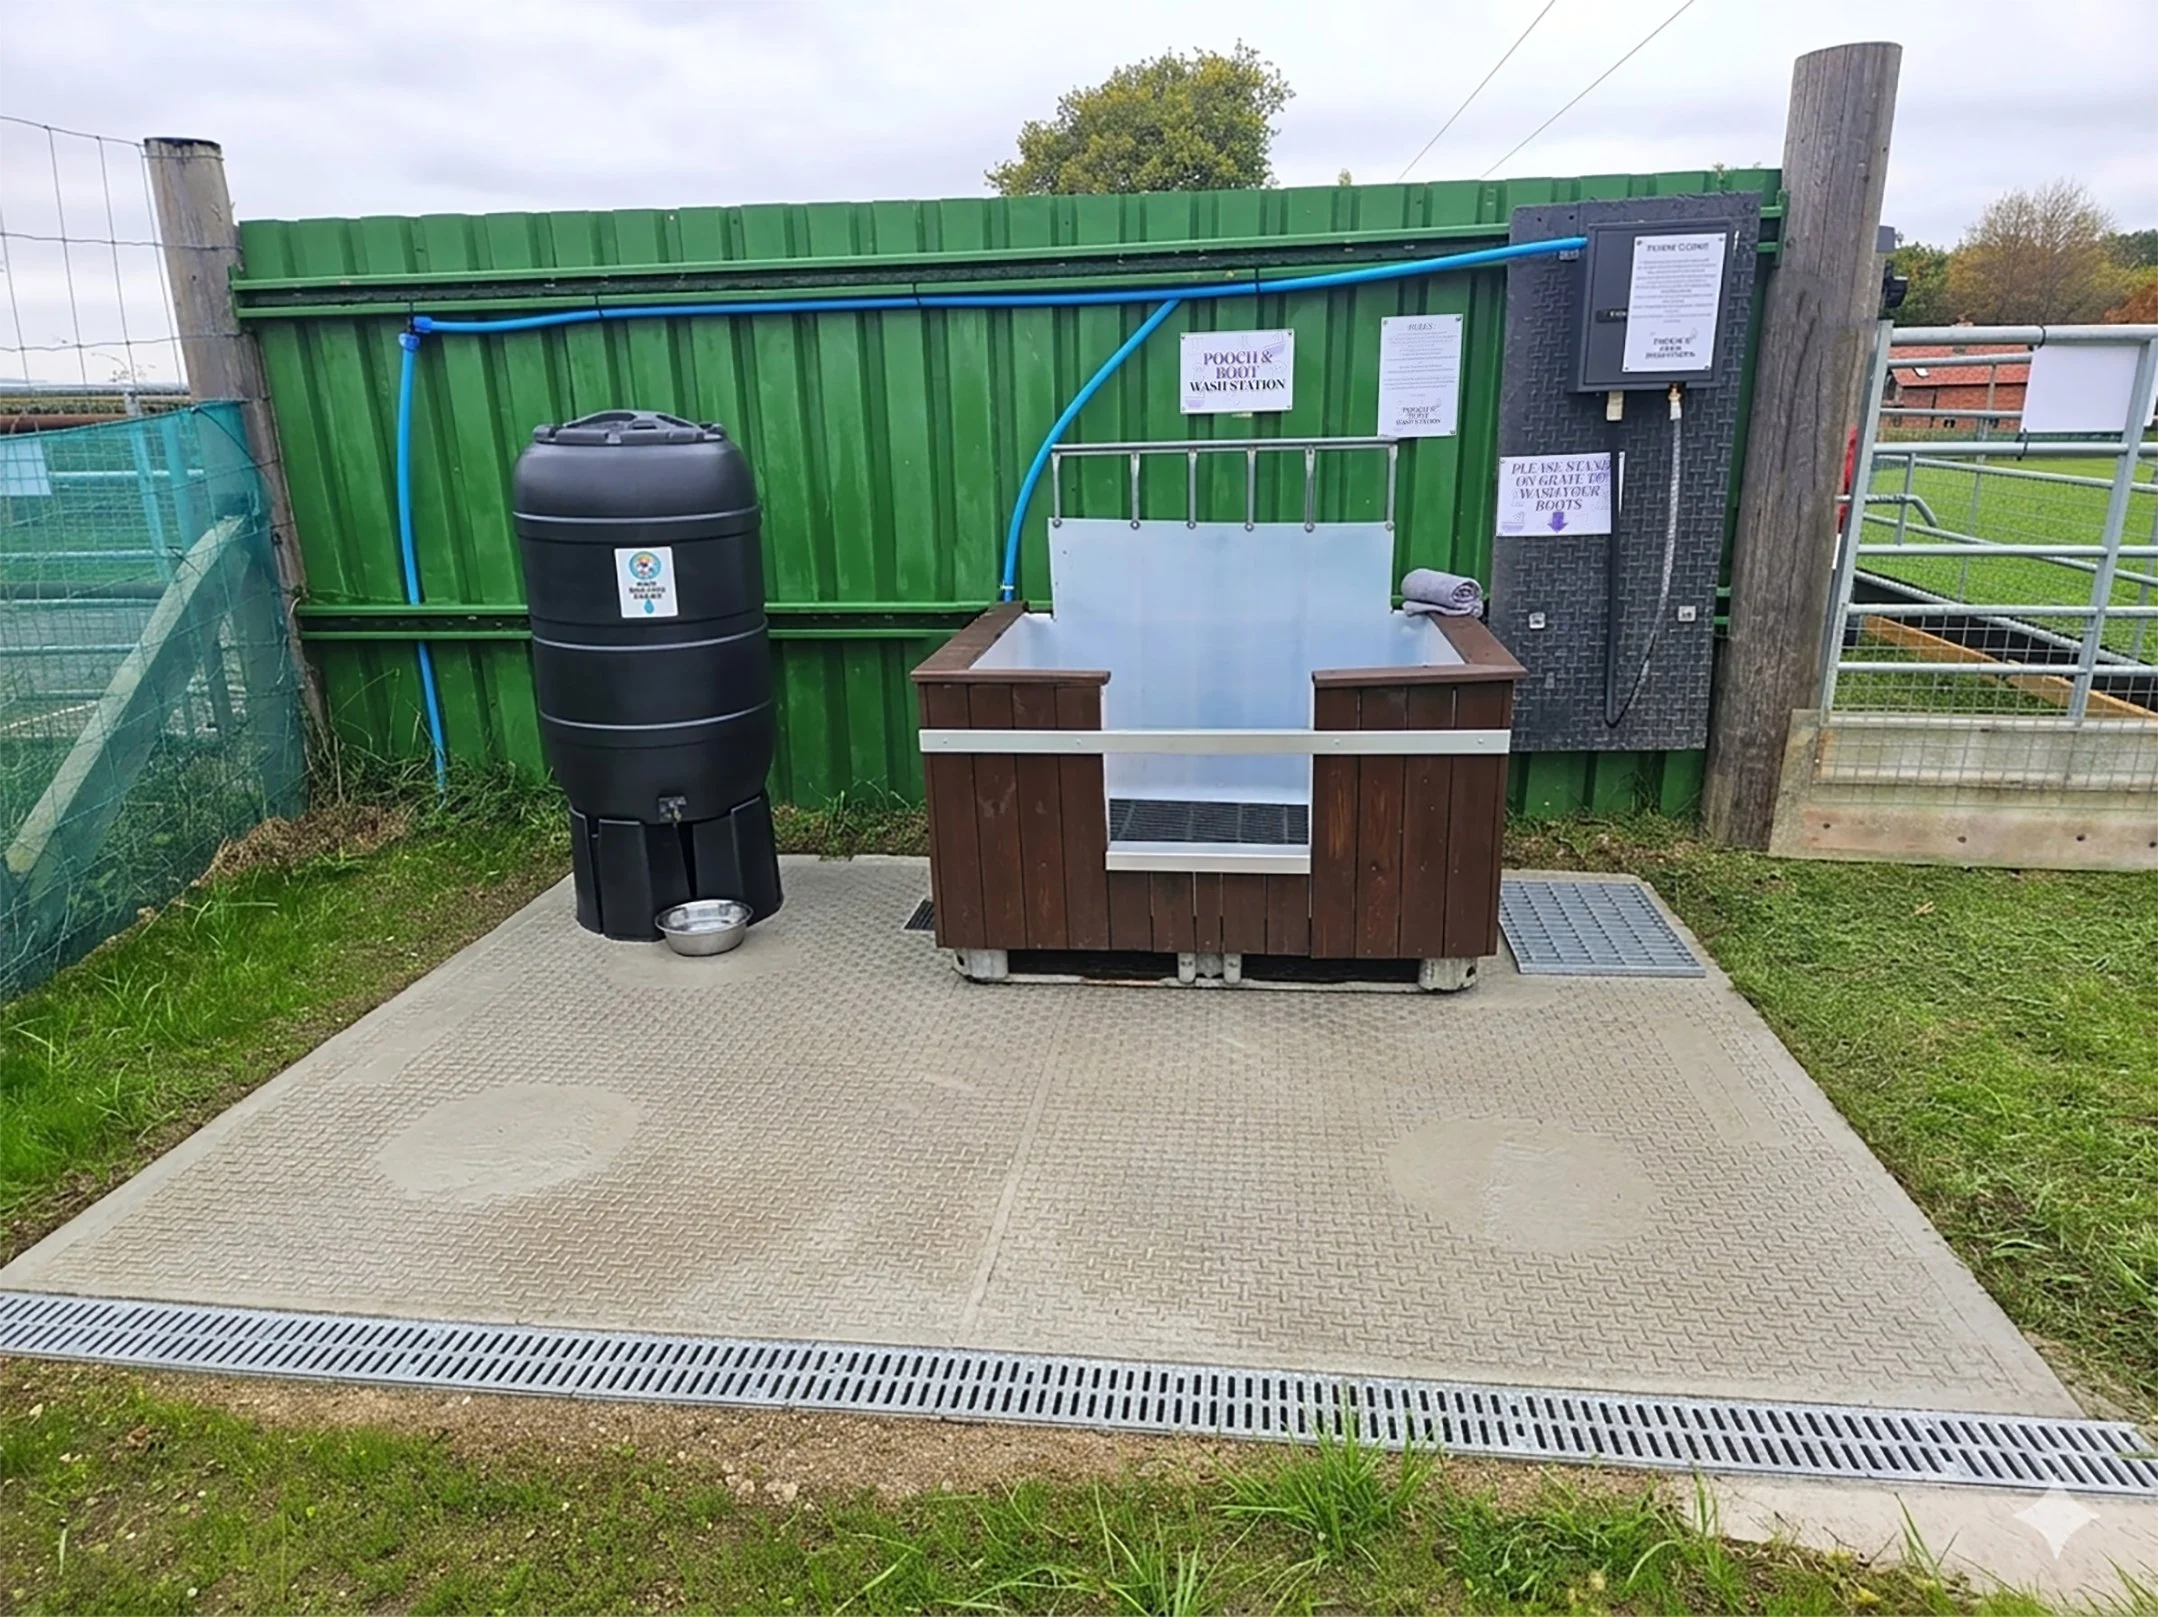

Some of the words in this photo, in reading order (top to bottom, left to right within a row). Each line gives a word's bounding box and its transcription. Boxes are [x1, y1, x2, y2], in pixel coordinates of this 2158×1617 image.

[1203, 351, 1258, 365] POOCH
[1260, 351, 1273, 363] &
[1216, 366, 1257, 379] BOOT
[1190, 381, 1227, 392] WASH
[1229, 379, 1285, 391] STATION
[1512, 462, 1562, 475] PLEASE
[1516, 474, 1536, 487] ON
[1538, 473, 1586, 486] GRATE
[1588, 471, 1608, 484] TO
[1520, 487, 1562, 499] WASH
[1563, 485, 1601, 498] YOUR
[1536, 500, 1582, 511] BOOTS
